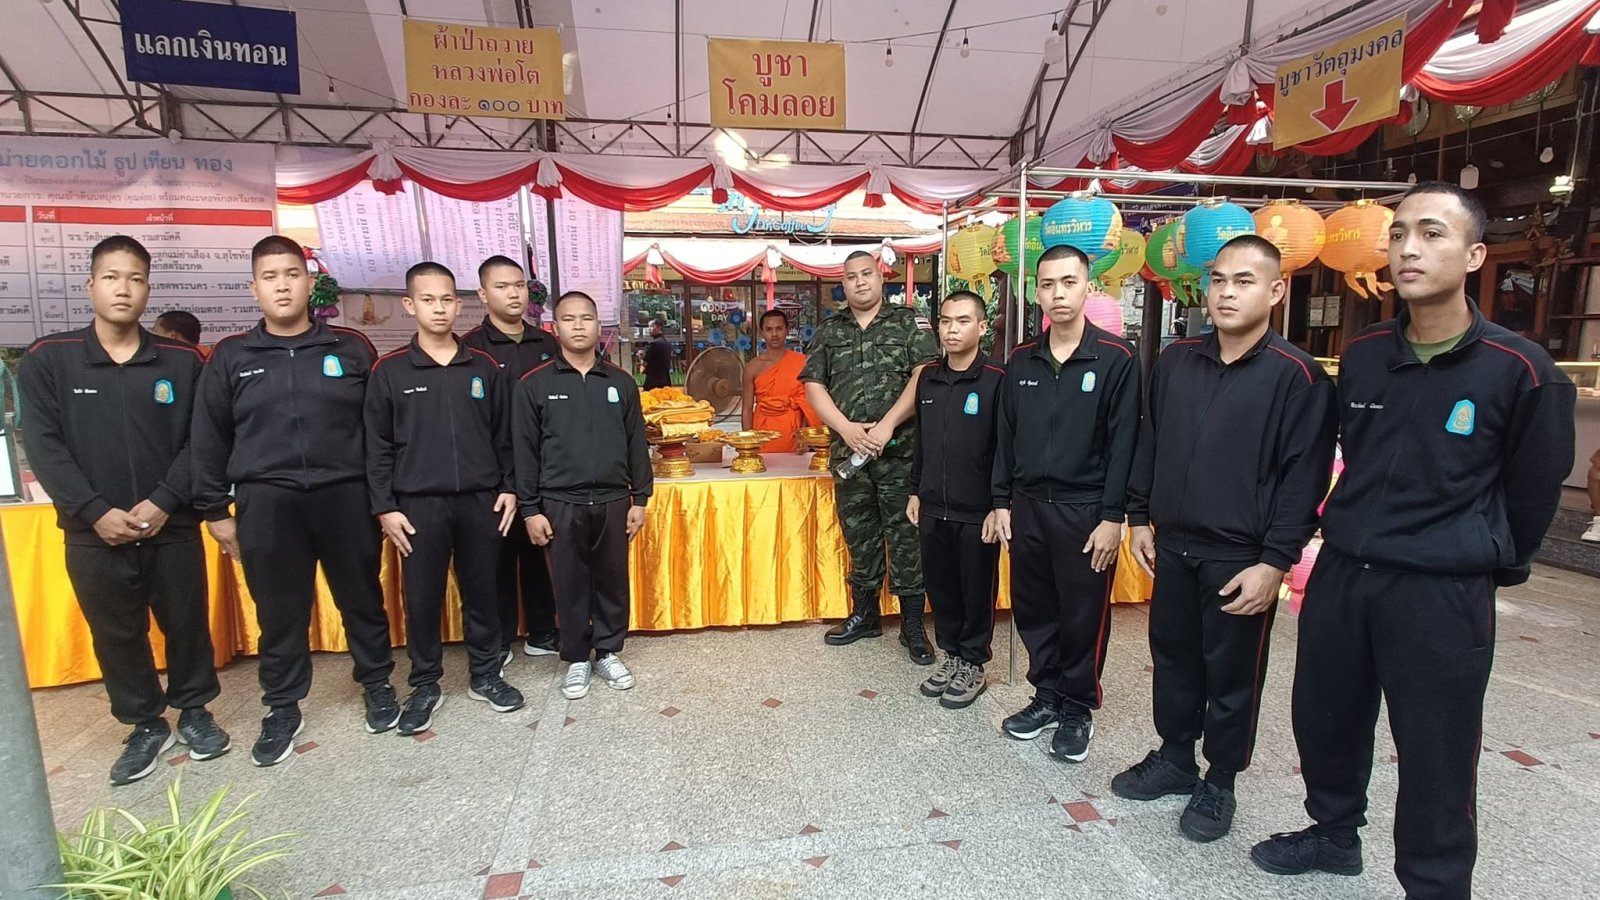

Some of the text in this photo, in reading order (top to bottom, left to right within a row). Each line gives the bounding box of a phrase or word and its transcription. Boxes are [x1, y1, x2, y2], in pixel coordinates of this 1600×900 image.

[134, 29, 288, 66] แลกเงินทอน
[433, 25, 534, 55] ผ้าป่าถวาย
[432, 58, 540, 85] หลวงพ่อโต
[752, 53, 808, 87] บูชา
[1279, 29, 1403, 97] บูชาวัตถุมงคล
[409, 92, 564, 114] กองละ ๑๐๐ บาท
[722, 78, 835, 117] โคมลอย
[115, 151, 137, 177] ธูป
[143, 150, 186, 169] เทียน
[194, 158, 233, 172] ทอง
[37, 210, 55, 220] วันที่
[701, 302, 727, 313] GOOD
[711, 314, 729, 323] DAY
